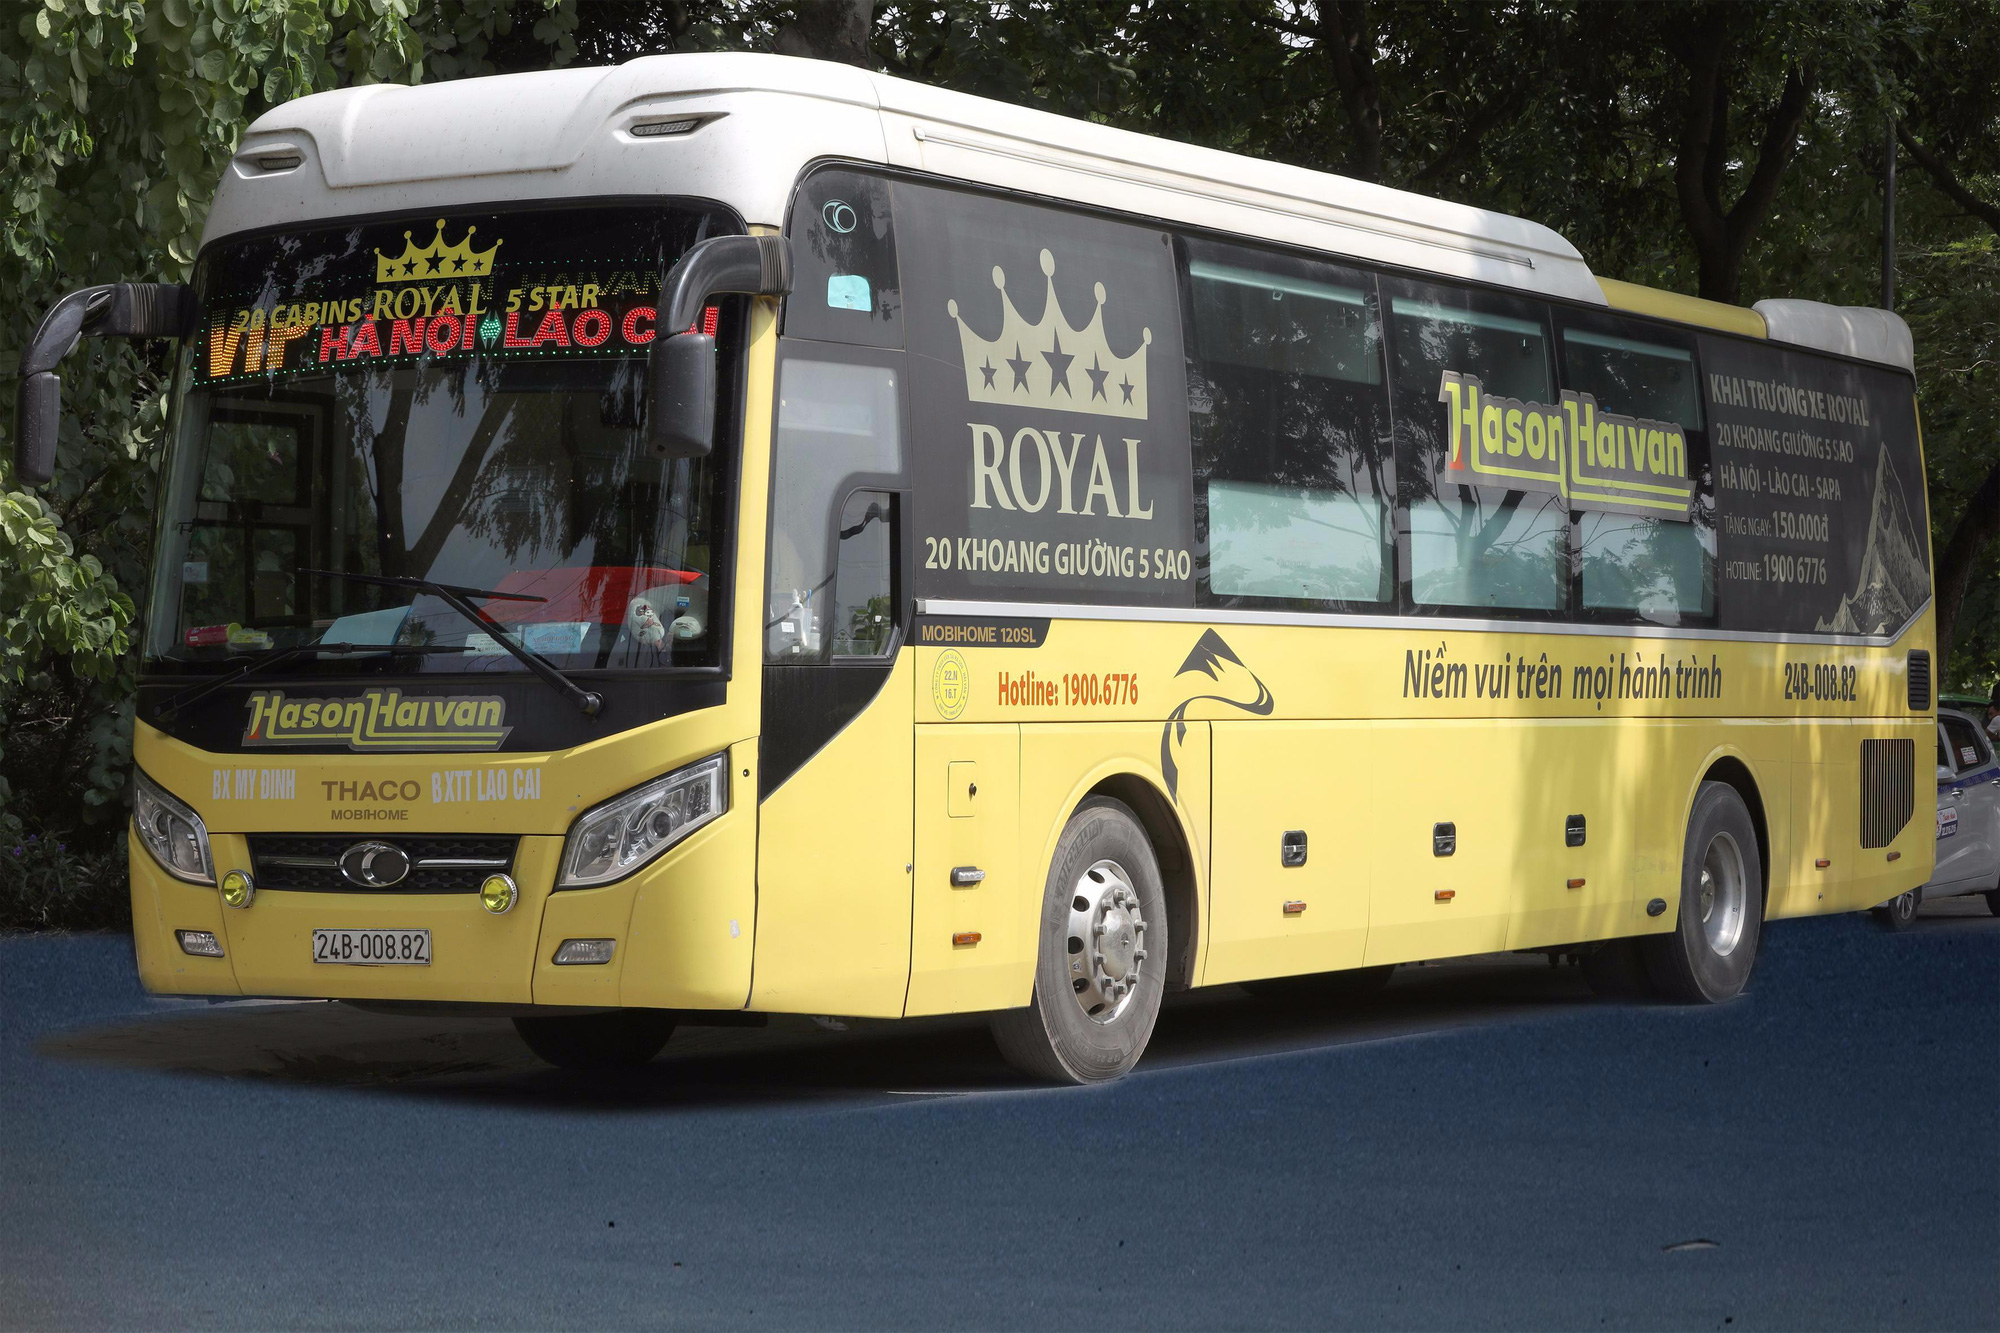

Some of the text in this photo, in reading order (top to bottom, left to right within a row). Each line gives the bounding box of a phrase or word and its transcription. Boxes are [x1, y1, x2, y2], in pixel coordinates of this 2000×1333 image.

[236, 298, 362, 332] 20 CABINS
[372, 284, 487, 320] ROYAL
[505, 284, 599, 313] 5 STAR
[210, 298, 312, 377] VIP
[622, 305, 719, 346] CI
[1710, 373, 1870, 427] KHAI TRƯƠNG XE ROYAL
[1444, 381, 1563, 468] Hason
[1716, 422, 1854, 464] 20 KHOANG GIƯỜNG 5 SAO
[966, 423, 1154, 520] ROYAL
[1720, 460, 1738, 490] HÀ
[1740, 463, 1761, 498] NỘI
[1768, 466, 1790, 496] LÀO
[1791, 473, 1810, 498] CAI
[1816, 476, 1841, 501] SAPA
[1748, 517, 1771, 537] NGAY:
[1772, 511, 1829, 542] 150.000đ
[924, 536, 1191, 581] 20 KHOANG GIƯỜNG 5 SAO
[1725, 554, 1827, 585] HOTLINE: 1900 6776
[921, 625, 1037, 643] MOBIHOME 120SL
[998, 671, 1139, 707] Hotline: 1900.6776
[1402, 641, 1723, 711] Niềm vui trên mọi hành trình
[1784, 661, 1857, 702] 24B-008.82
[251, 695, 364, 736] Hason
[212, 768, 231, 800] BX
[235, 768, 257, 800] MY
[321, 780, 421, 802] THACO
[477, 768, 508, 801] LAO
[513, 767, 541, 800] CAI
[331, 809, 409, 820] MOBIHOME
[317, 933, 426, 961] 24B-008.82
